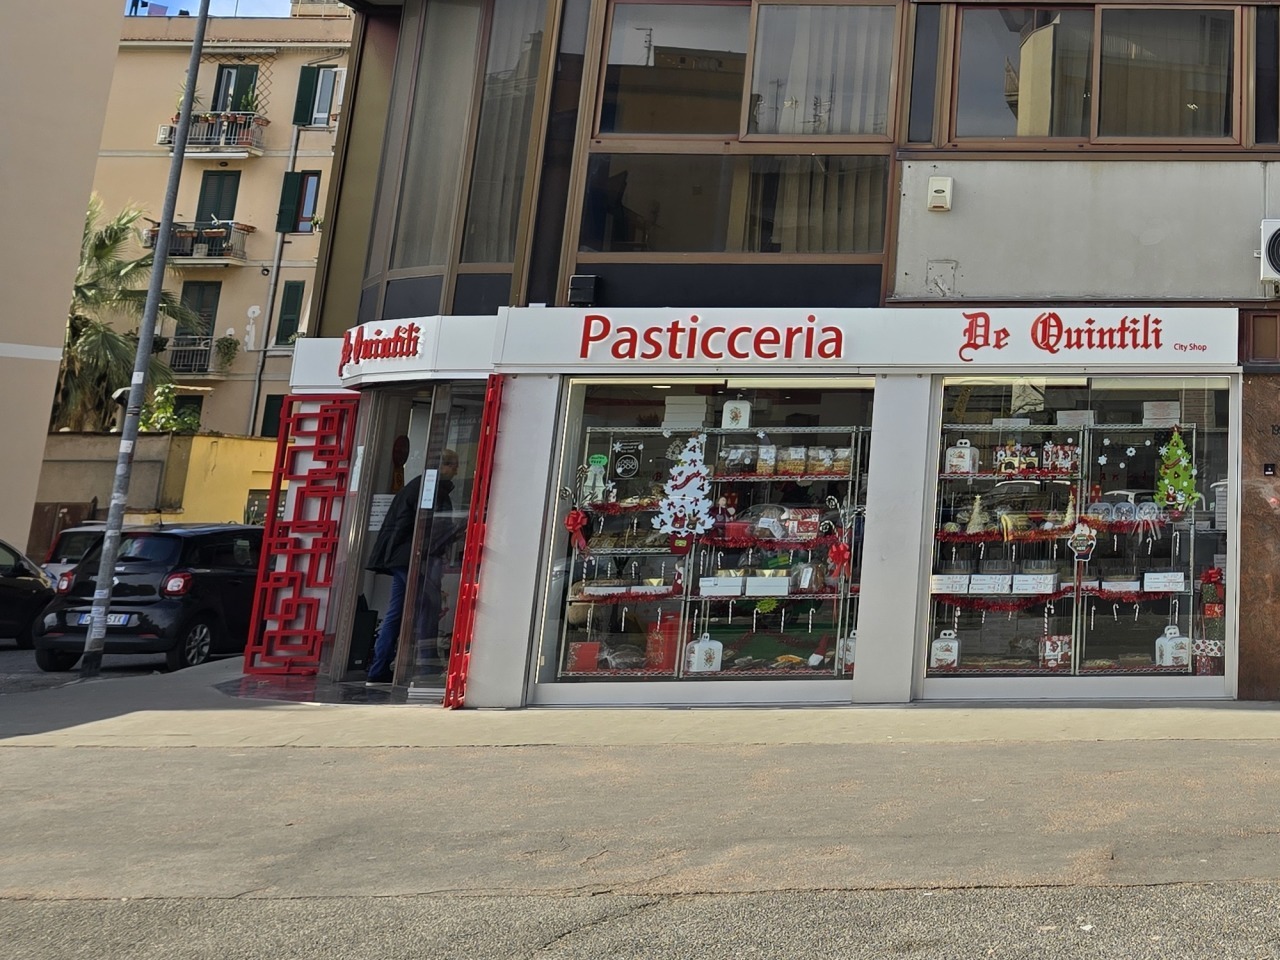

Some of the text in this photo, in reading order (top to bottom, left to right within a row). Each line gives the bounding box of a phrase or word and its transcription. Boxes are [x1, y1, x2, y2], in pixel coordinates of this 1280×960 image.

[579, 314, 844, 359] Pasticceria
[959, 312, 1163, 362] De Quintili
[1174, 343, 1207, 352] City Shop
